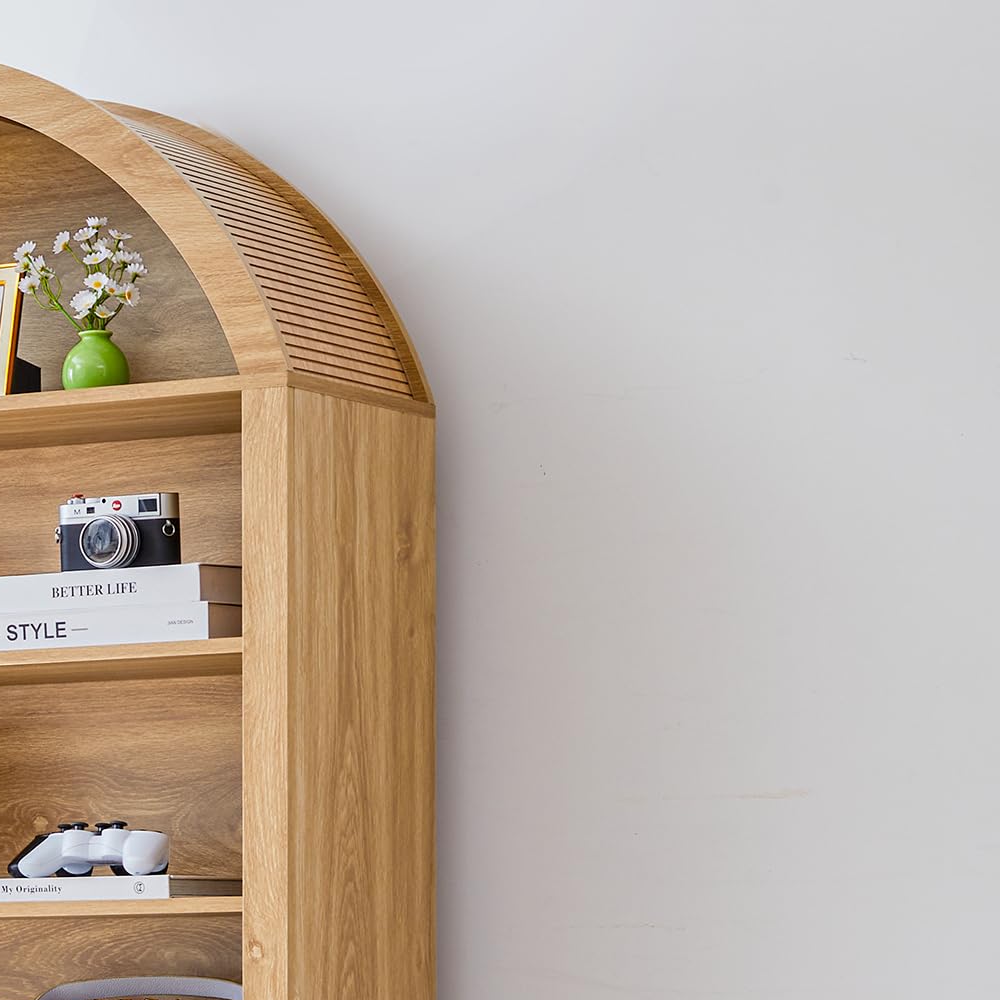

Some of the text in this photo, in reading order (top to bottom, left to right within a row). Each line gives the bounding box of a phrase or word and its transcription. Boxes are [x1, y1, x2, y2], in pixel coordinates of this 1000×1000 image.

[51, 581, 138, 599] BETTER LIFE
[6, 621, 67, 642] STYLE
[1, 885, 14, 896] My
[15, 884, 63, 895] Originality
